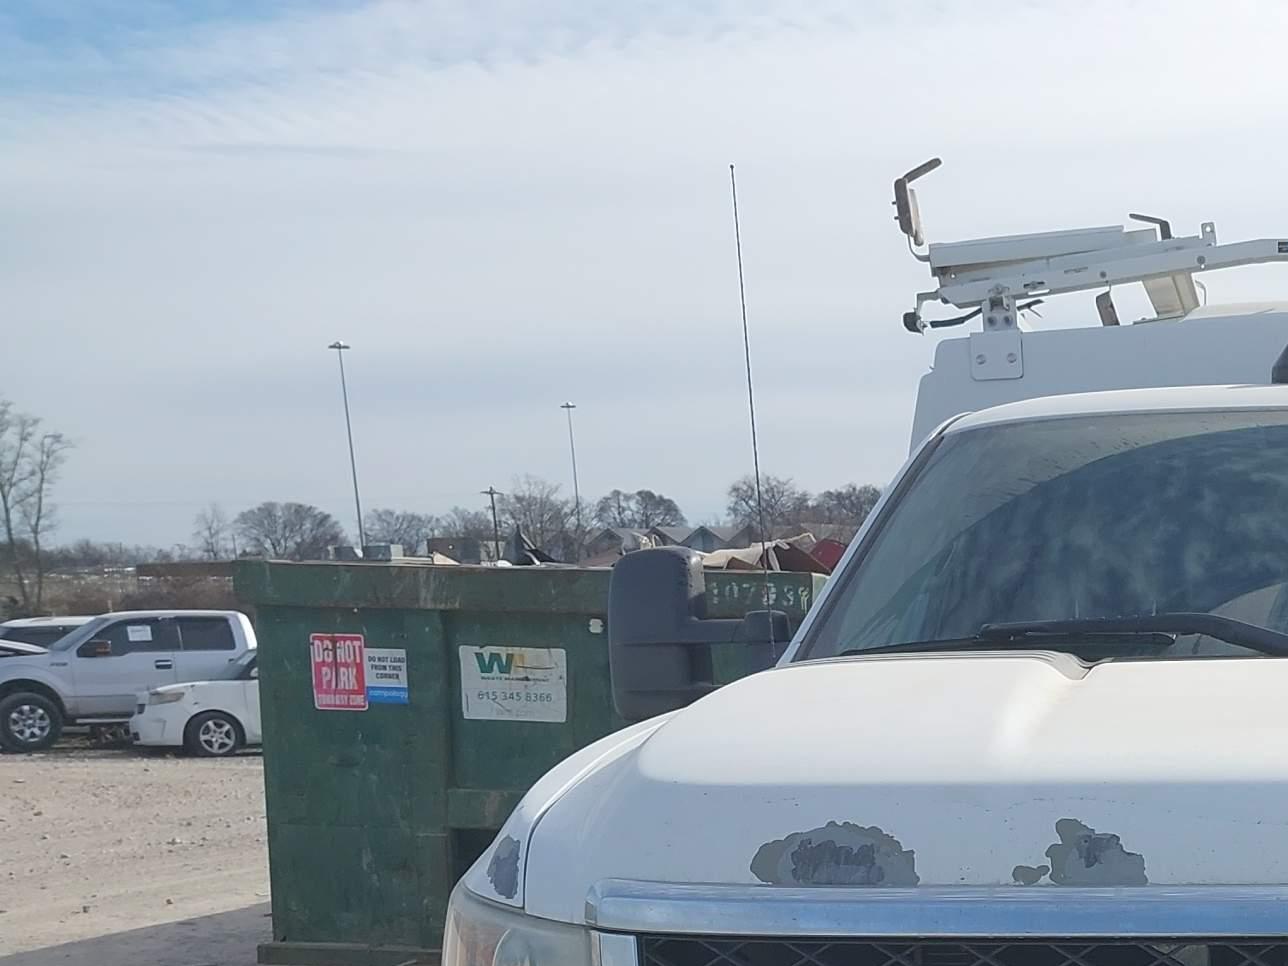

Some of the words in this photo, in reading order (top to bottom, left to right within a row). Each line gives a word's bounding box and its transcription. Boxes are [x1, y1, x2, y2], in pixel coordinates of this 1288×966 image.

[313, 640, 333, 662] DO
[336, 640, 361, 663] NOT
[478, 691, 498, 700] 615
[501, 692, 521, 701] 345
